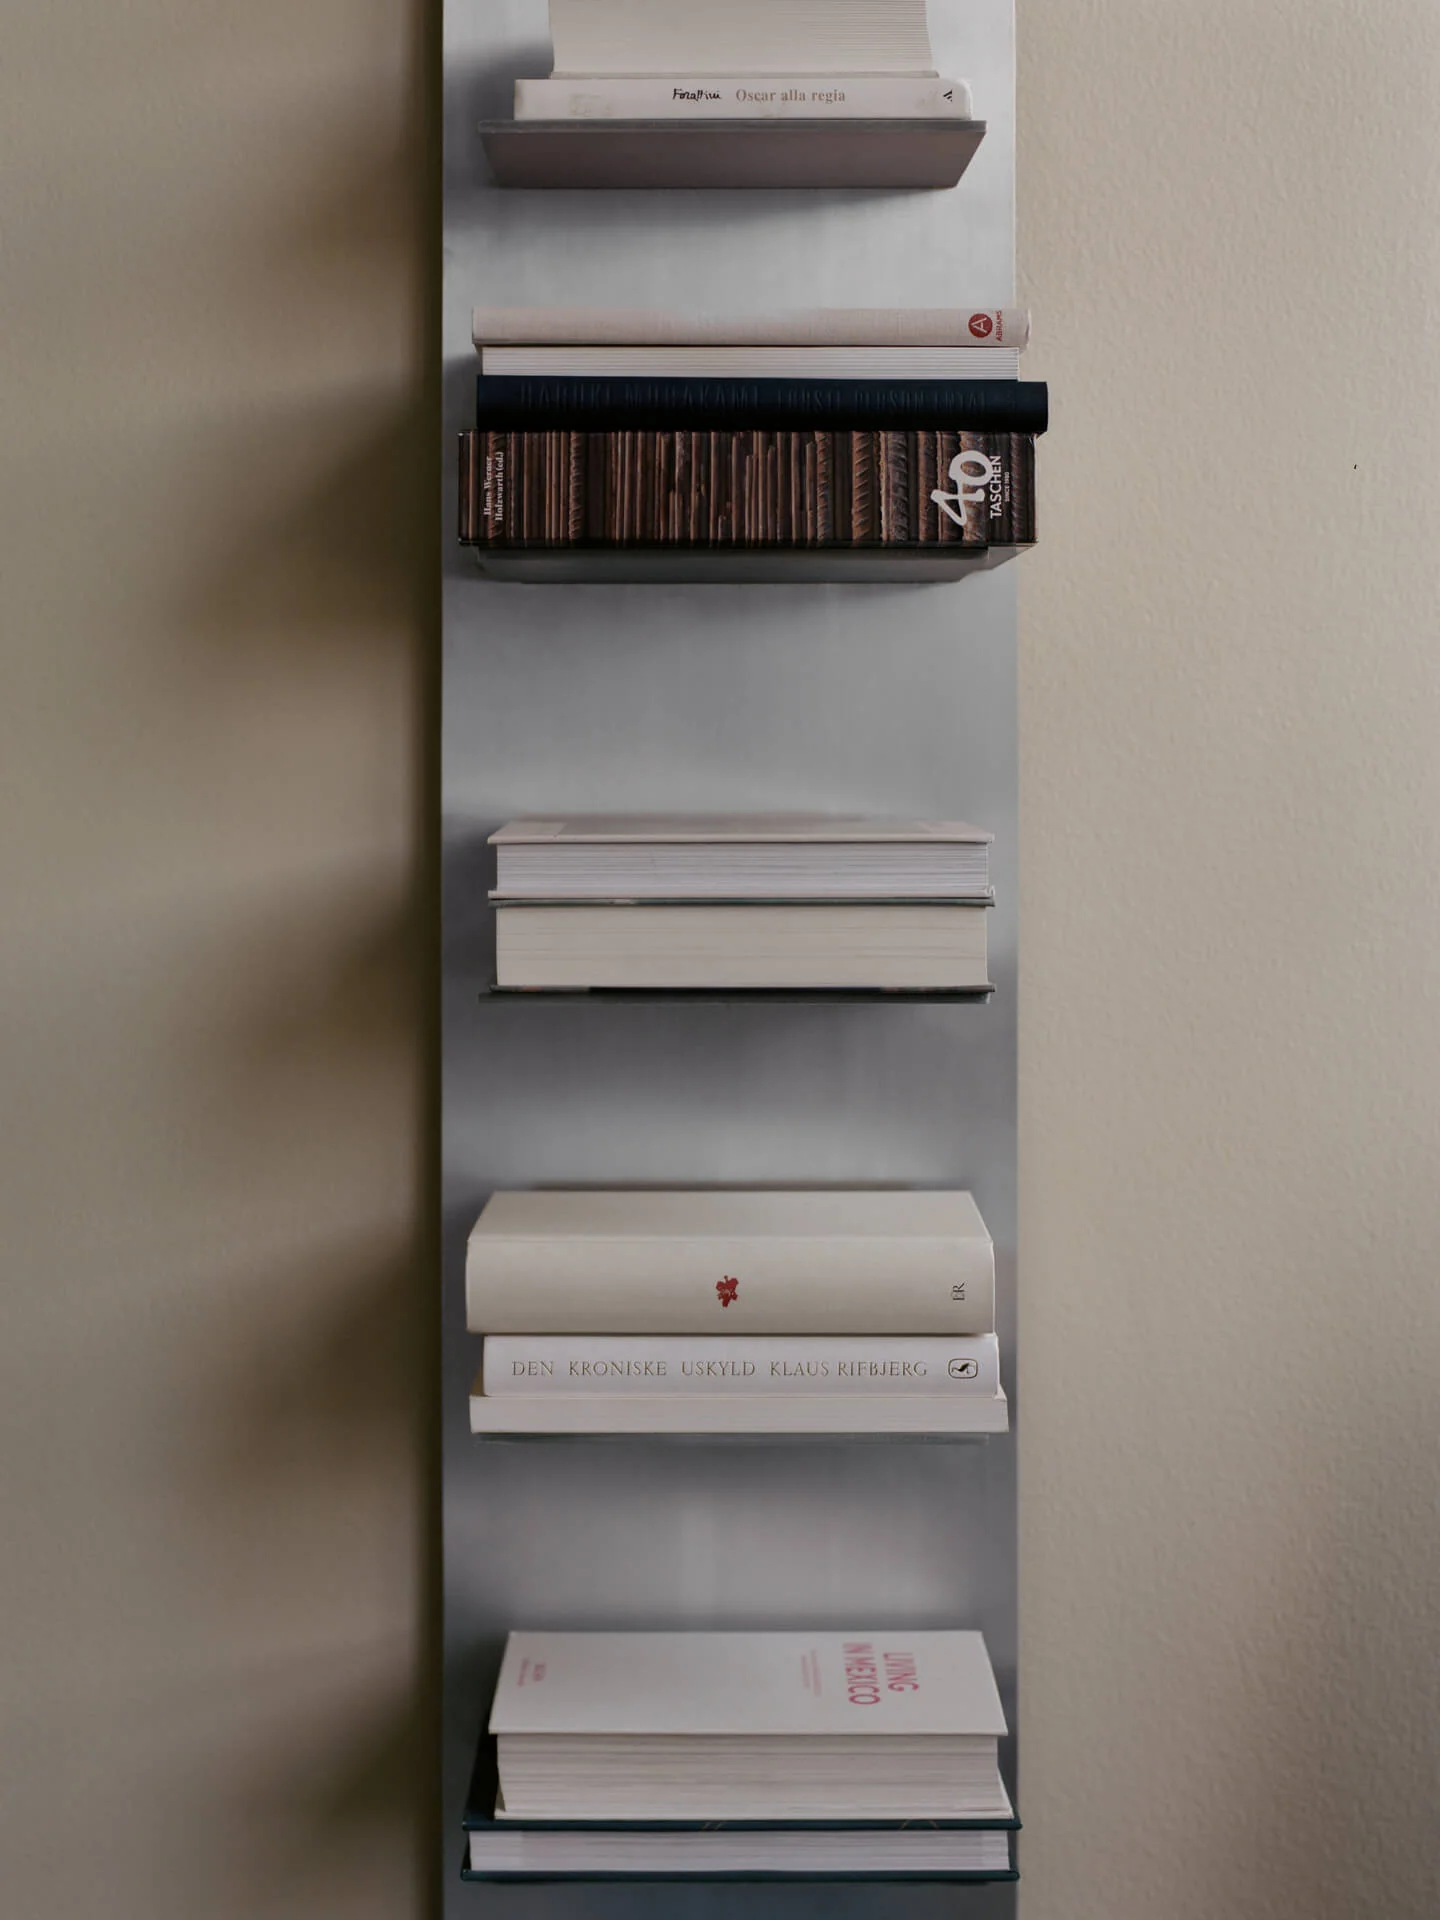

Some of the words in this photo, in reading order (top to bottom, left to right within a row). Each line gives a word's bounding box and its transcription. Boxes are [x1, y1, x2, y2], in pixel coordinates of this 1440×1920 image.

[736, 88, 776, 102] Oscar
[780, 88, 806, 102] alla
[811, 88, 845, 104] regia
[483, 456, 492, 489] Werner
[930, 450, 993, 526] 40
[989, 455, 1002, 519] TASCHEN
[483, 491, 492, 516] Hans
[495, 471, 504, 521] Holzwarth
[512, 1360, 554, 1377] DEN
[568, 1360, 668, 1377] KRONISKE
[681, 1360, 756, 1377] USKYLD
[770, 1361, 829, 1377] KLAUS
[838, 1361, 928, 1377] RIFBJERG
[844, 1656, 881, 1705] MEXICO
[883, 1652, 920, 1692] LIVING
